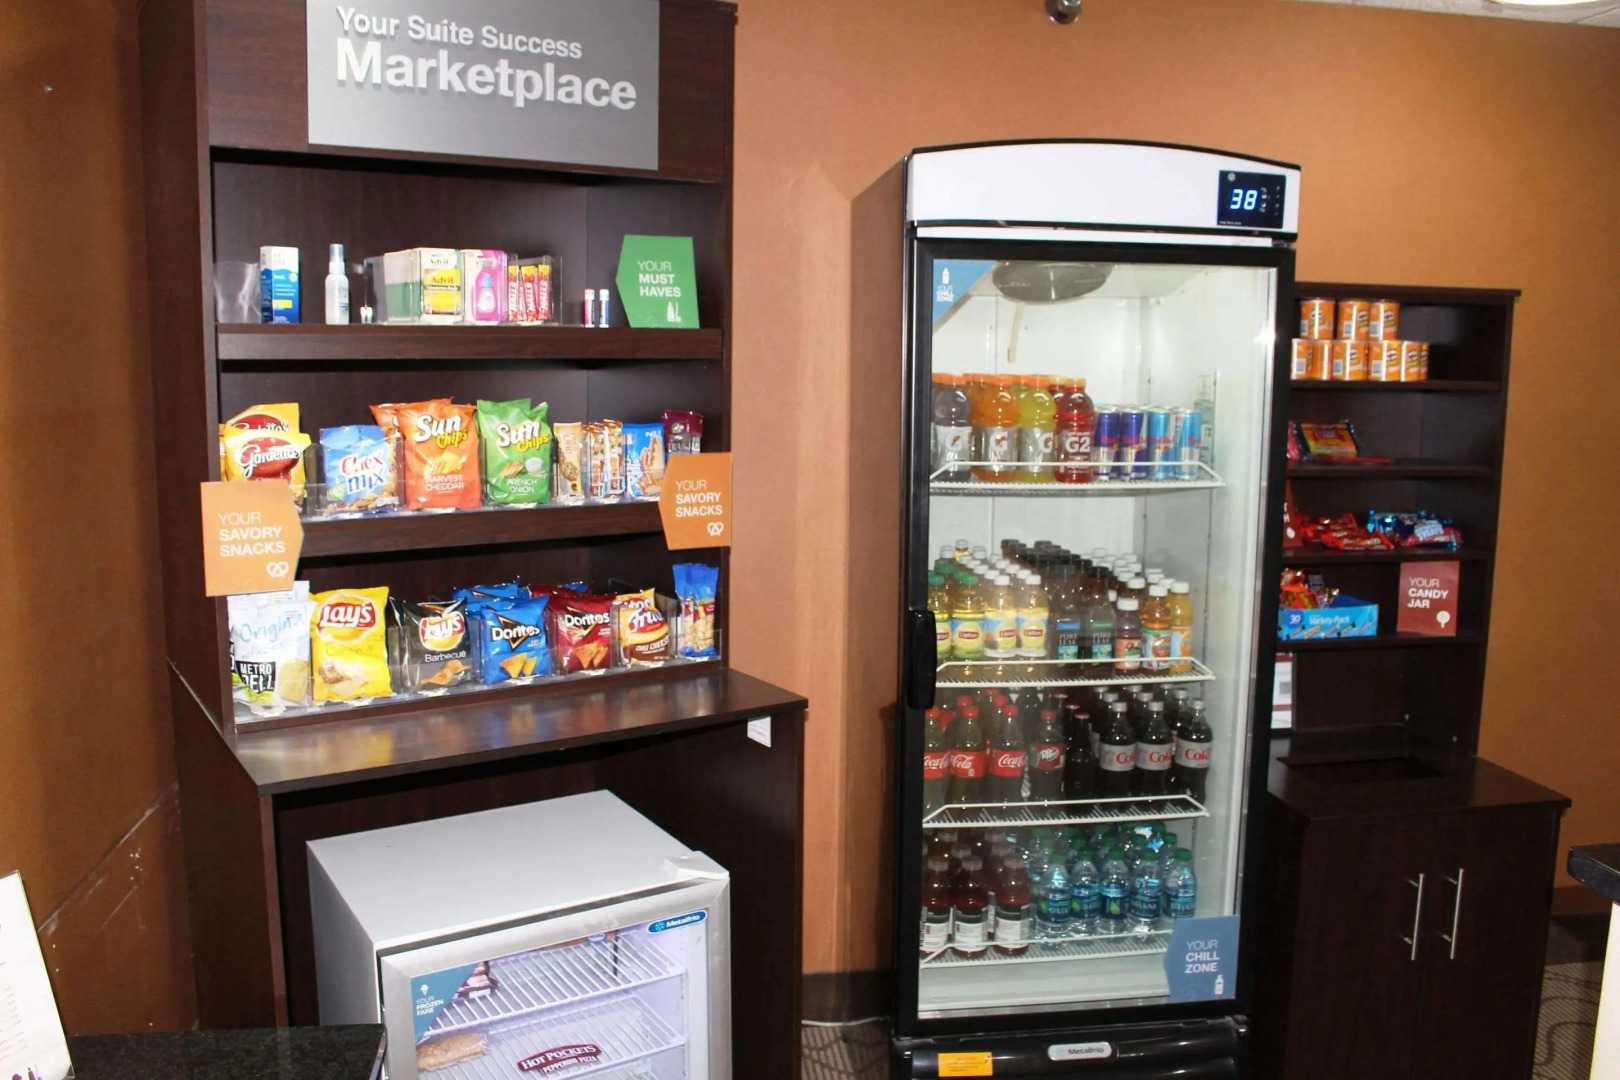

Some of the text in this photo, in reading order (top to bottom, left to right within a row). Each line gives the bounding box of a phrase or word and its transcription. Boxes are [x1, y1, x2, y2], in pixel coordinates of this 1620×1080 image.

[336, 6, 583, 59] Your Suite Success
[336, 37, 637, 110] Marketplace
[1229, 188, 1258, 210] 38
[637, 260, 672, 272] YOUR
[638, 272, 675, 285] MUST
[639, 286, 681, 298] HAVES
[413, 414, 461, 443] Sun
[496, 420, 541, 447] Sun
[436, 429, 469, 448] Chips
[515, 433, 549, 452] Chips
[1065, 436, 1091, 453] G2
[425, 482, 464, 491] CHEDDAR
[506, 478, 538, 486] FRENCH
[675, 479, 707, 490] YOUR
[675, 492, 722, 505] SAVORY
[675, 505, 723, 518] SNACKS
[218, 511, 262, 526] YOUR
[219, 526, 283, 542] SAVORY
[220, 541, 286, 557] SNACKS
[1409, 577, 1440, 588] YOUR
[1408, 588, 1449, 600] CANDY
[1407, 599, 1431, 609] JAR
[564, 612, 610, 627] Doritos
[425, 651, 466, 663] Barbecue
[240, 663, 273, 676] METRO
[666, 915, 701, 928] Metalfrio
[1186, 940, 1219, 951] YOUR
[1185, 951, 1220, 963] CHILL
[1185, 962, 1218, 974] ZONE
[521, 1045, 597, 1070] HOT POCKETS
[1068, 1047, 1105, 1055] Metalfrio
